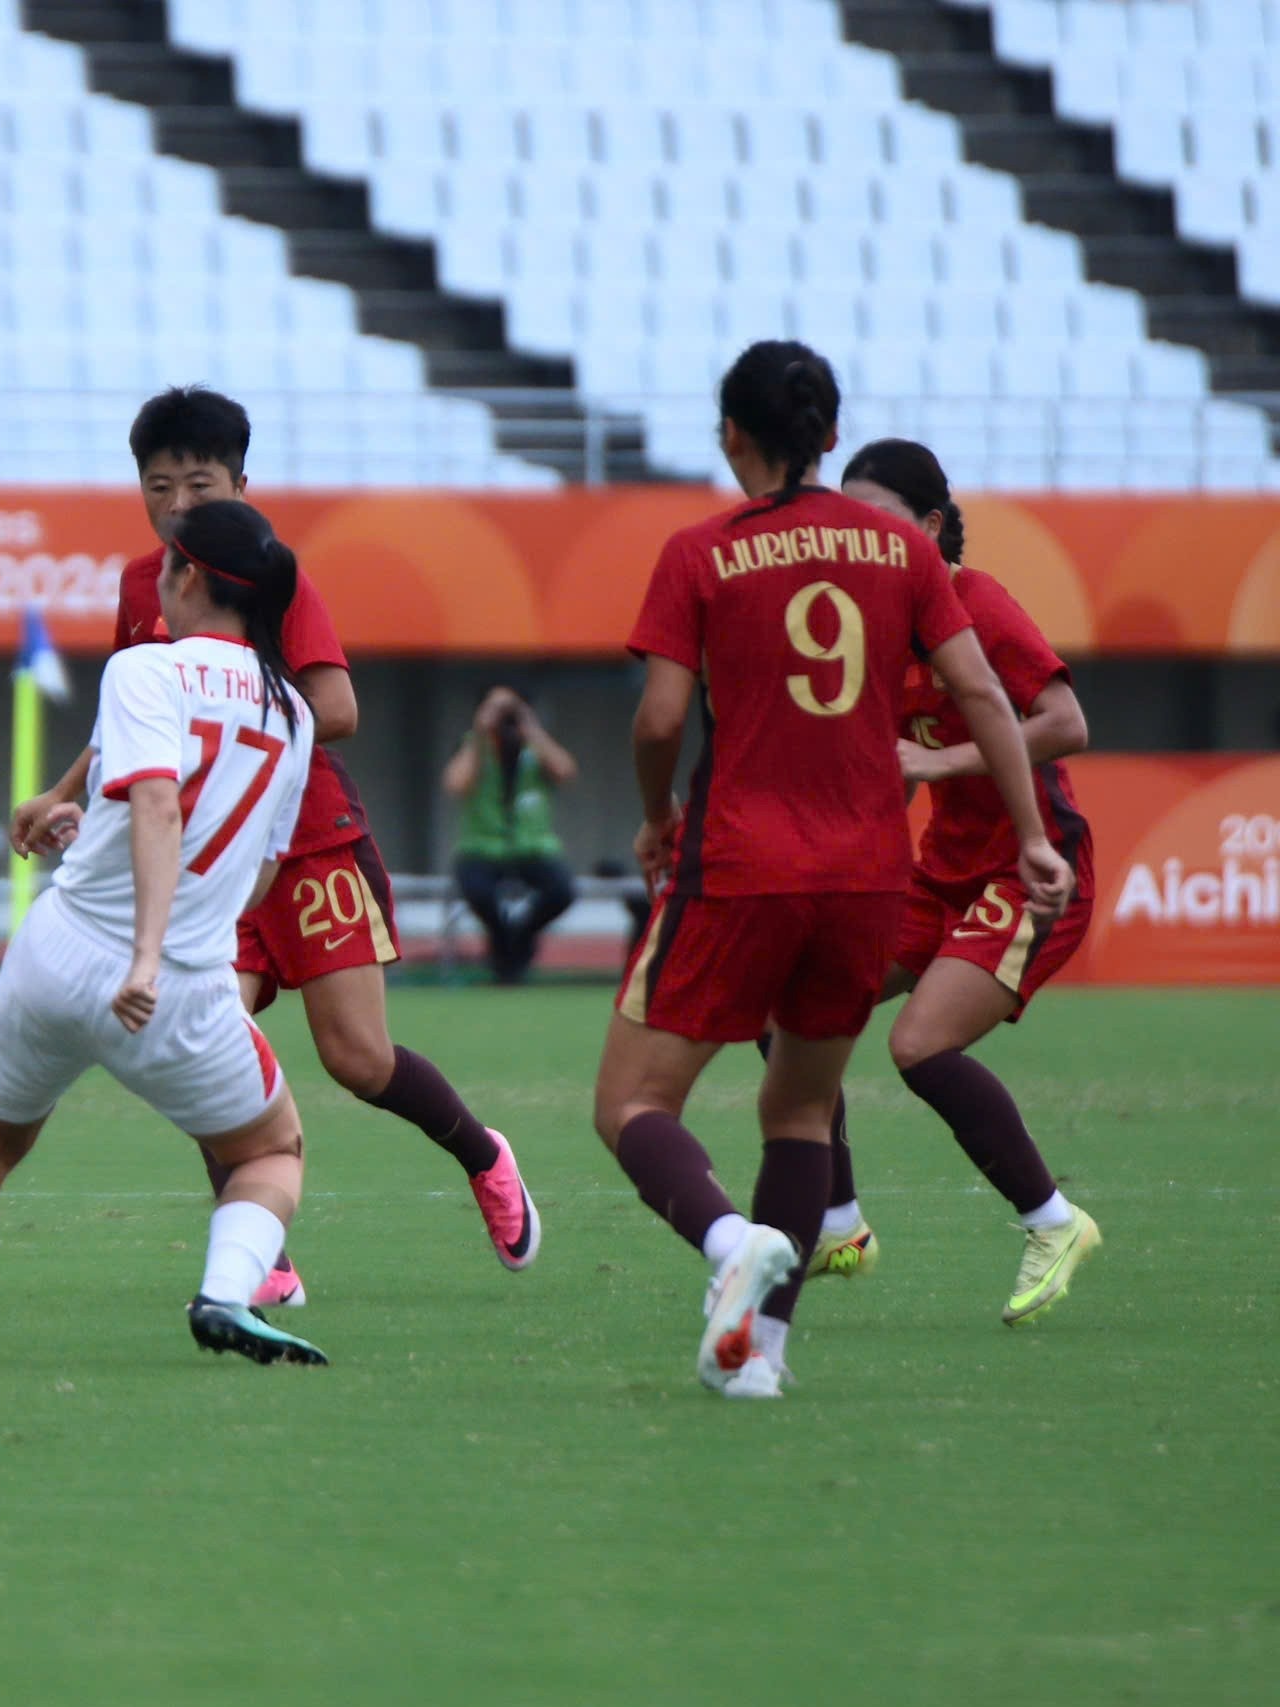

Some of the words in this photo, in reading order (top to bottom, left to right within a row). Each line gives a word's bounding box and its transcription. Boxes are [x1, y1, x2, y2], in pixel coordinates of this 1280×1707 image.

[712, 526, 908, 580] WURIGUMULA
[785, 581, 864, 717] 9
[179, 718, 286, 877] 17
[1220, 814, 1280, 855] 20
[293, 868, 364, 936] 20
